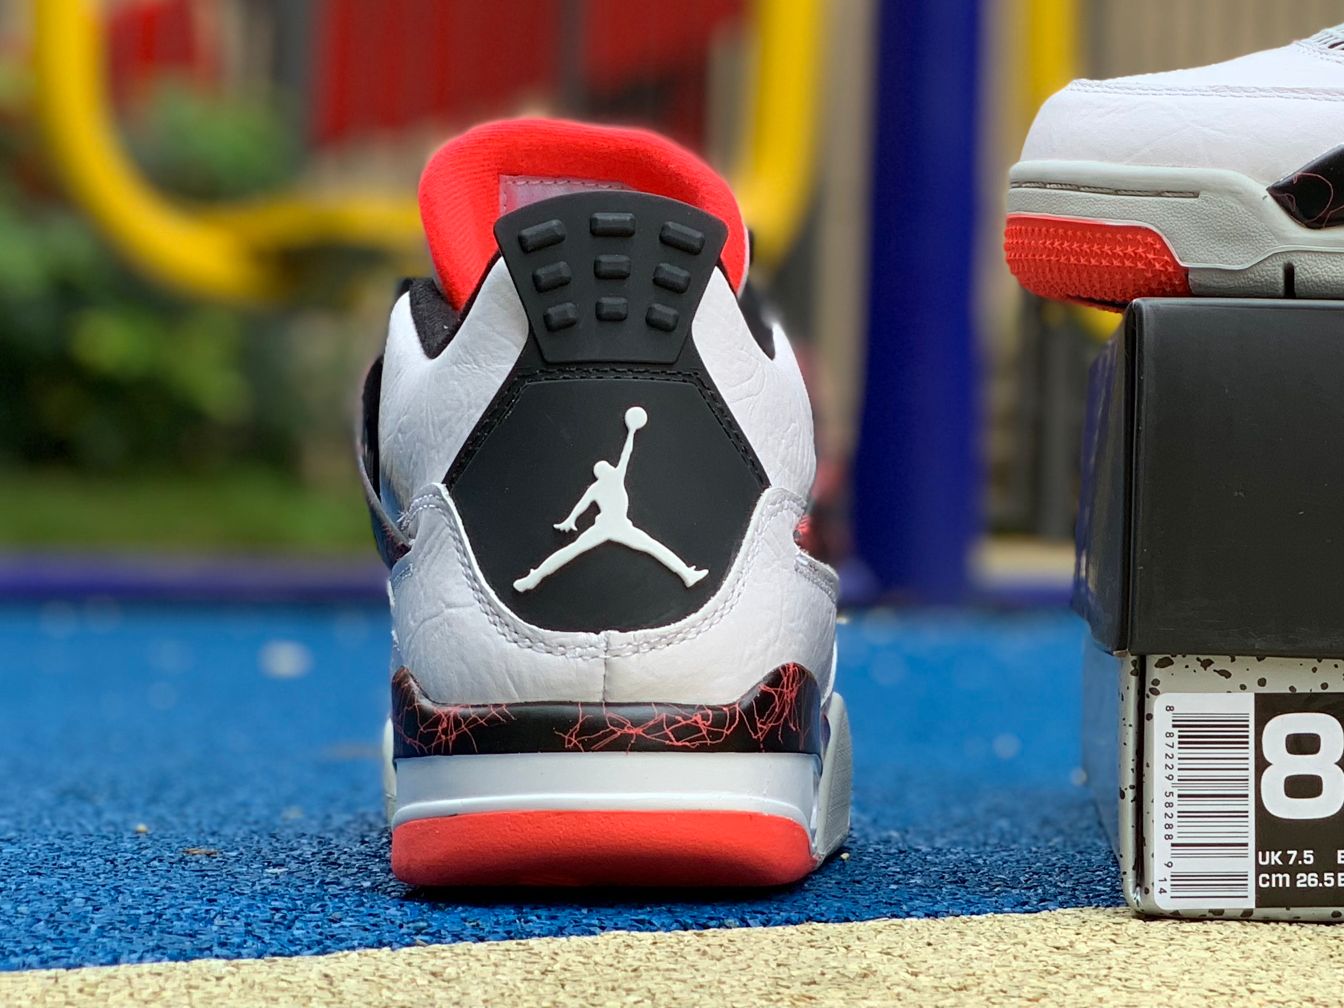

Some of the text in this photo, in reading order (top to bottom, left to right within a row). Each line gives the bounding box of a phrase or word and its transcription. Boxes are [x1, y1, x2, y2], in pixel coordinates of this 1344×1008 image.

[1258, 850, 1314, 866] UK 7.5
[1296, 872, 1335, 888] 26.5
